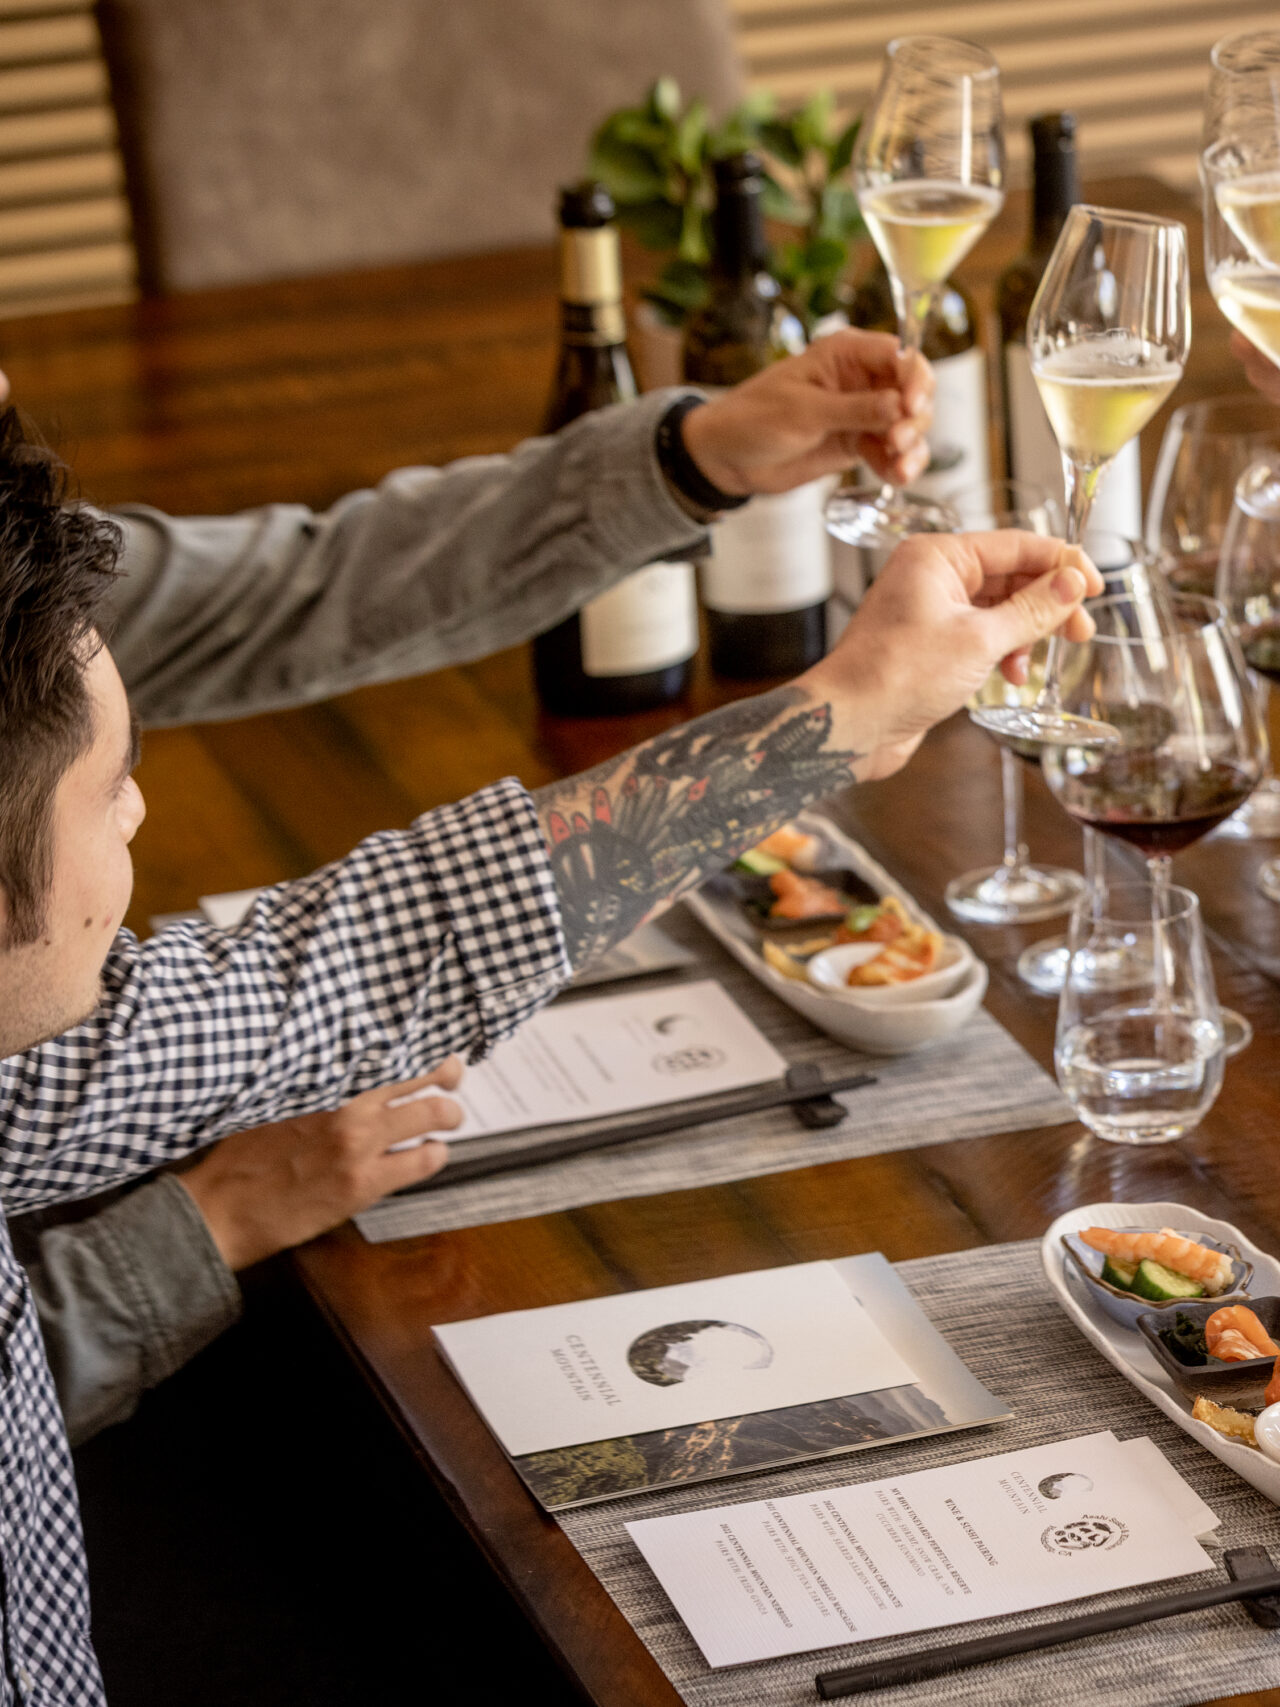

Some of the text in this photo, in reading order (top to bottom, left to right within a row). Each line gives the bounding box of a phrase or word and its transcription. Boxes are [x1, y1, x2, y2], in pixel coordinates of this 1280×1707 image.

[550, 1348, 594, 1401] MOUNTAIN
[565, 1334, 622, 1406] CENTENNIAL
[998, 1479, 1031, 1515] MOUNTAIN
[1010, 1471, 1047, 1514] CENTENNIAL
[761, 1521, 778, 1537] PAIRS
[784, 1556, 802, 1572] SPICY
[797, 1573, 812, 1590] TUNA
[772, 1512, 799, 1546] CENTENNIAL
[795, 1546, 818, 1575] MOUNTAIN
[816, 1576, 837, 1601] NERELLO
[809, 1504, 825, 1519] PAIRS
[833, 1538, 854, 1560] SEARED
[849, 1561, 869, 1585] SALMON
[831, 1511, 859, 1545] CENTENNIAL
[855, 1545, 878, 1574] MOUNTAIN
[874, 1574, 903, 1608] CARRICANTE
[875, 1490, 891, 1506] PAIRS
[915, 1547, 932, 1563] SNOW
[941, 1583, 954, 1595] AND
[876, 1513, 902, 1543] CUCUMBER
[897, 1496, 911, 1510] RHYS
[908, 1510, 932, 1539] VINEYARDS
[928, 1540, 954, 1570] PERPETUAL
[950, 1570, 972, 1594] RESERVE
[944, 1498, 961, 1515] WINE
[960, 1522, 980, 1540] SUSHI
[974, 1540, 998, 1566] PAIRING
[715, 1540, 730, 1556] PAIRS
[737, 1575, 755, 1594] FRIED
[727, 1534, 754, 1569] CENTENNIAL
[750, 1569, 773, 1599] MOUNTAIN
